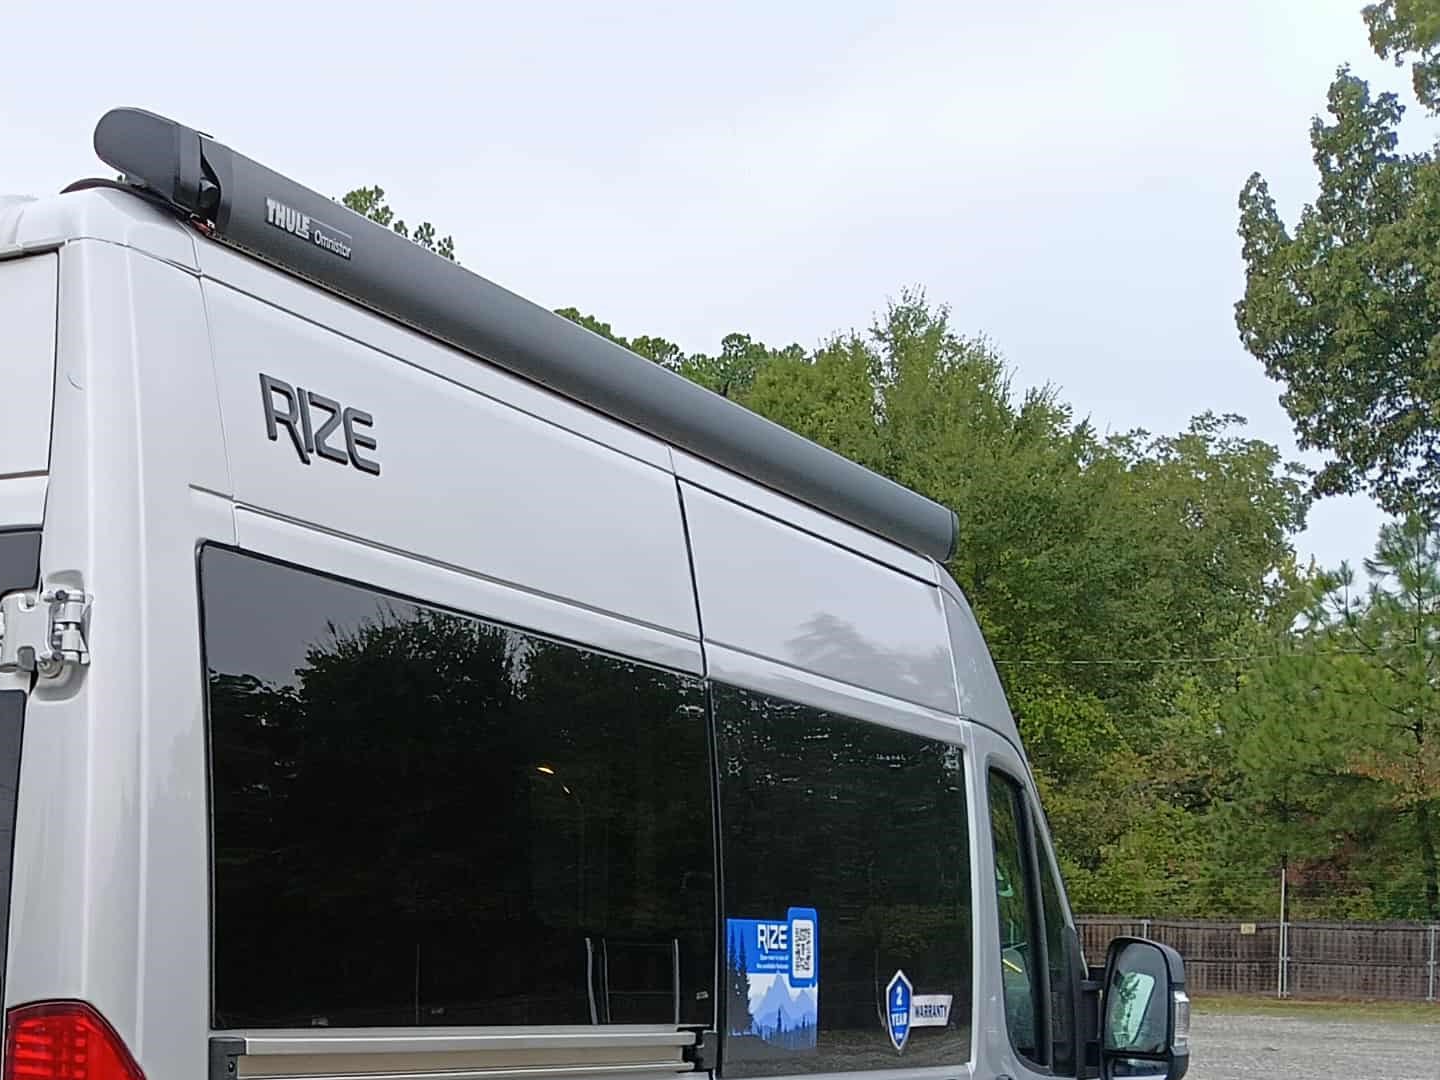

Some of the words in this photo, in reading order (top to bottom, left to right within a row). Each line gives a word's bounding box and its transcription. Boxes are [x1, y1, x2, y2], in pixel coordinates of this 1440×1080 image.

[265, 197, 311, 240] THULE
[314, 229, 352, 259] Omnistor
[259, 372, 380, 476] RIZE
[757, 924, 789, 954] RIZE
[895, 985, 903, 1006] 2
[890, 1012, 908, 1028] YEAR
[914, 1003, 948, 1018] WARRANTY
